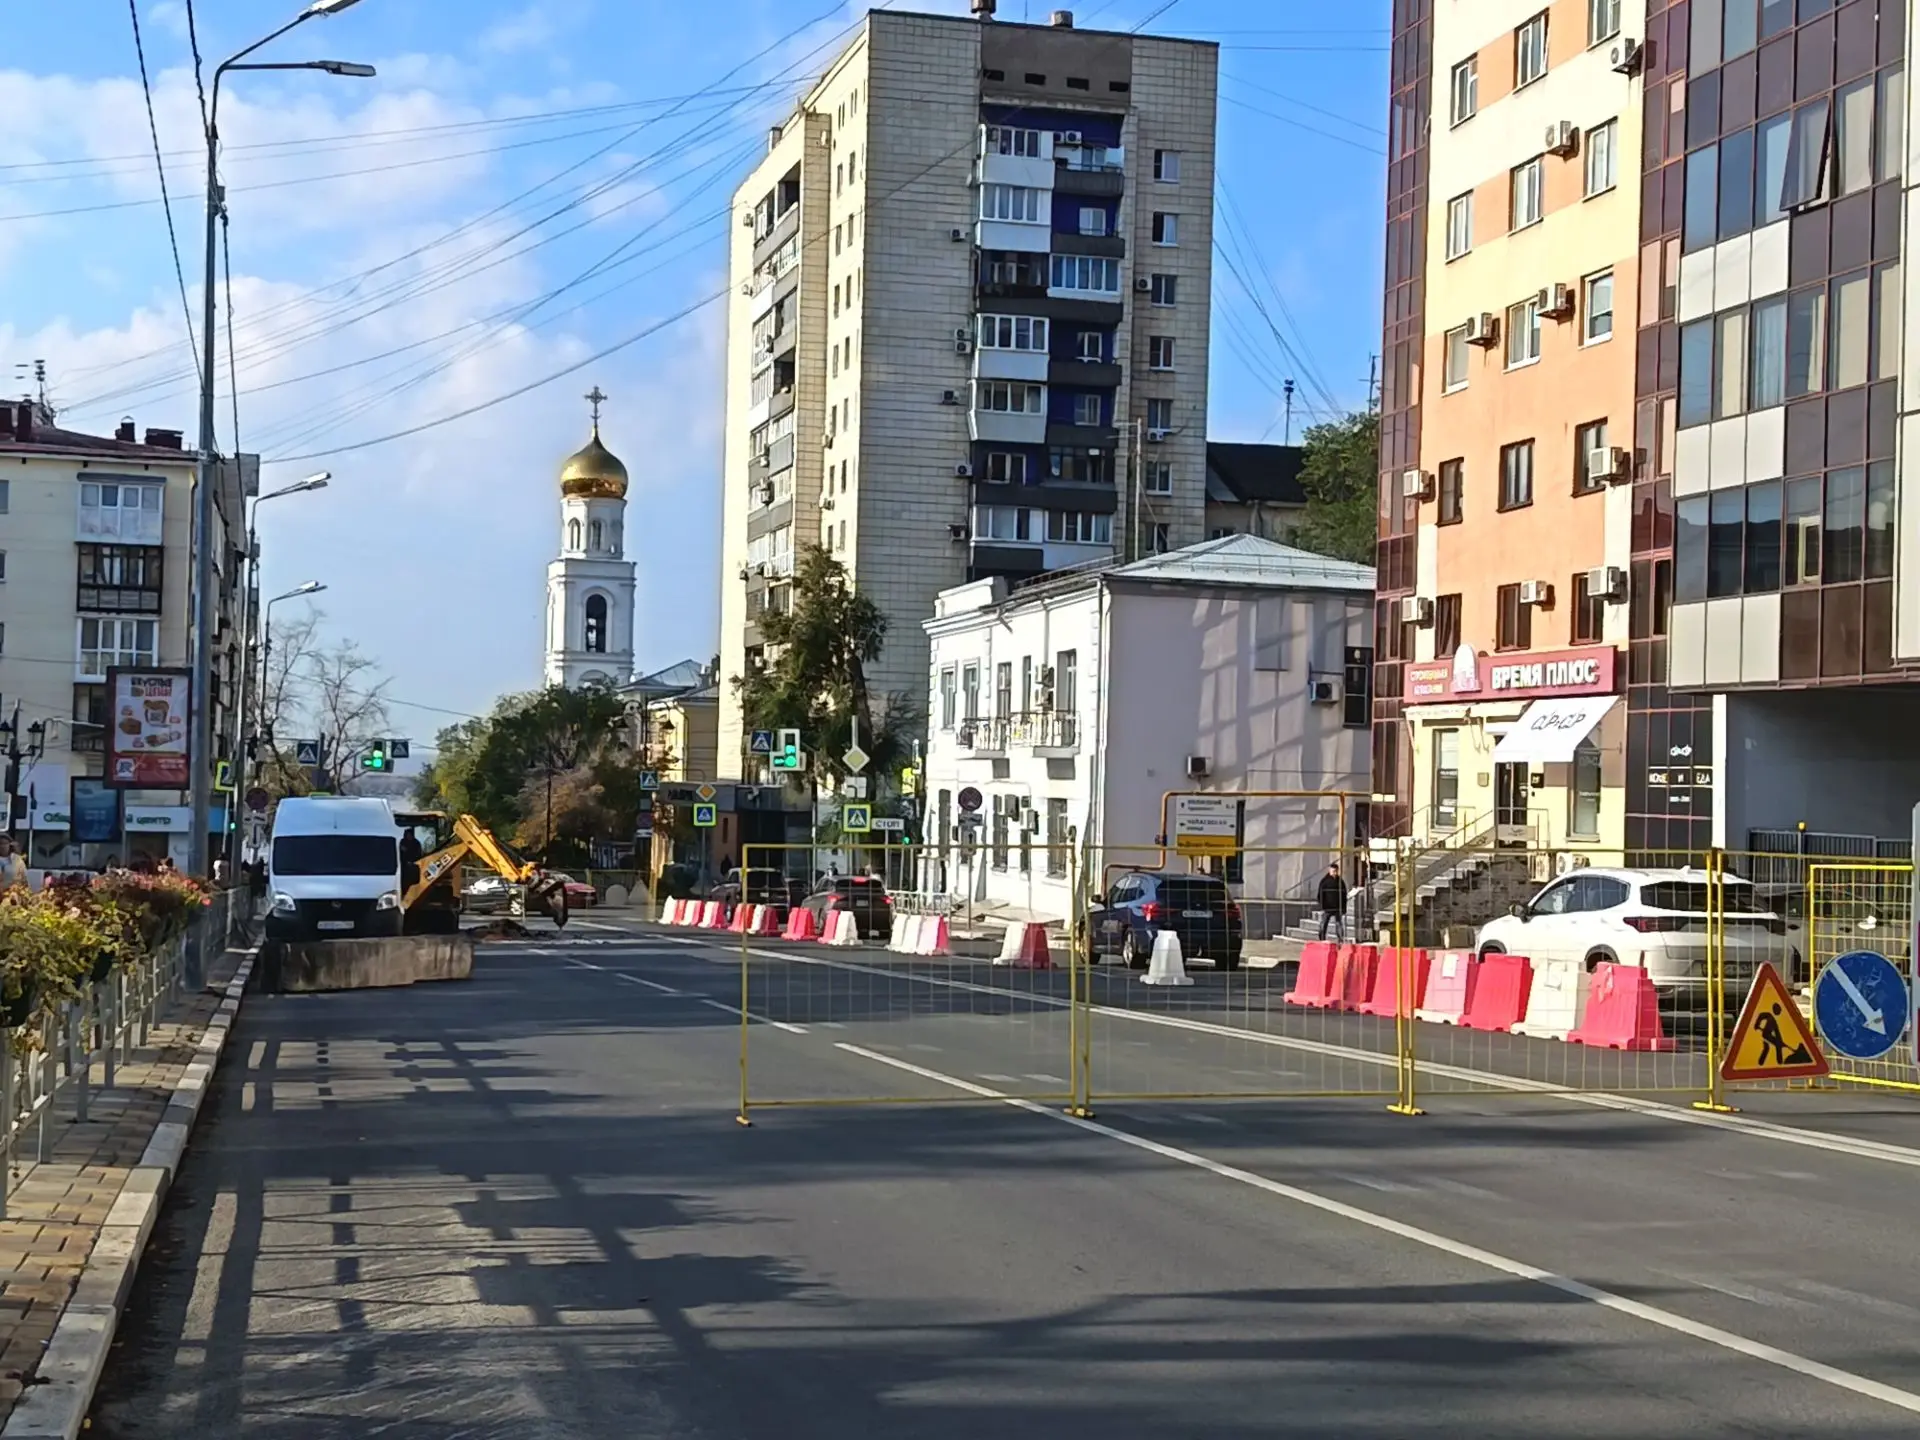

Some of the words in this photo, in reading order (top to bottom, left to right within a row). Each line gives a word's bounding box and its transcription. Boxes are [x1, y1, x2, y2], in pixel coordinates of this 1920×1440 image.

[1492, 663, 1543, 689] ВРЕМЯ
[1546, 658, 1597, 686] ПЛЮС
[875, 820, 900, 828] СТОП
